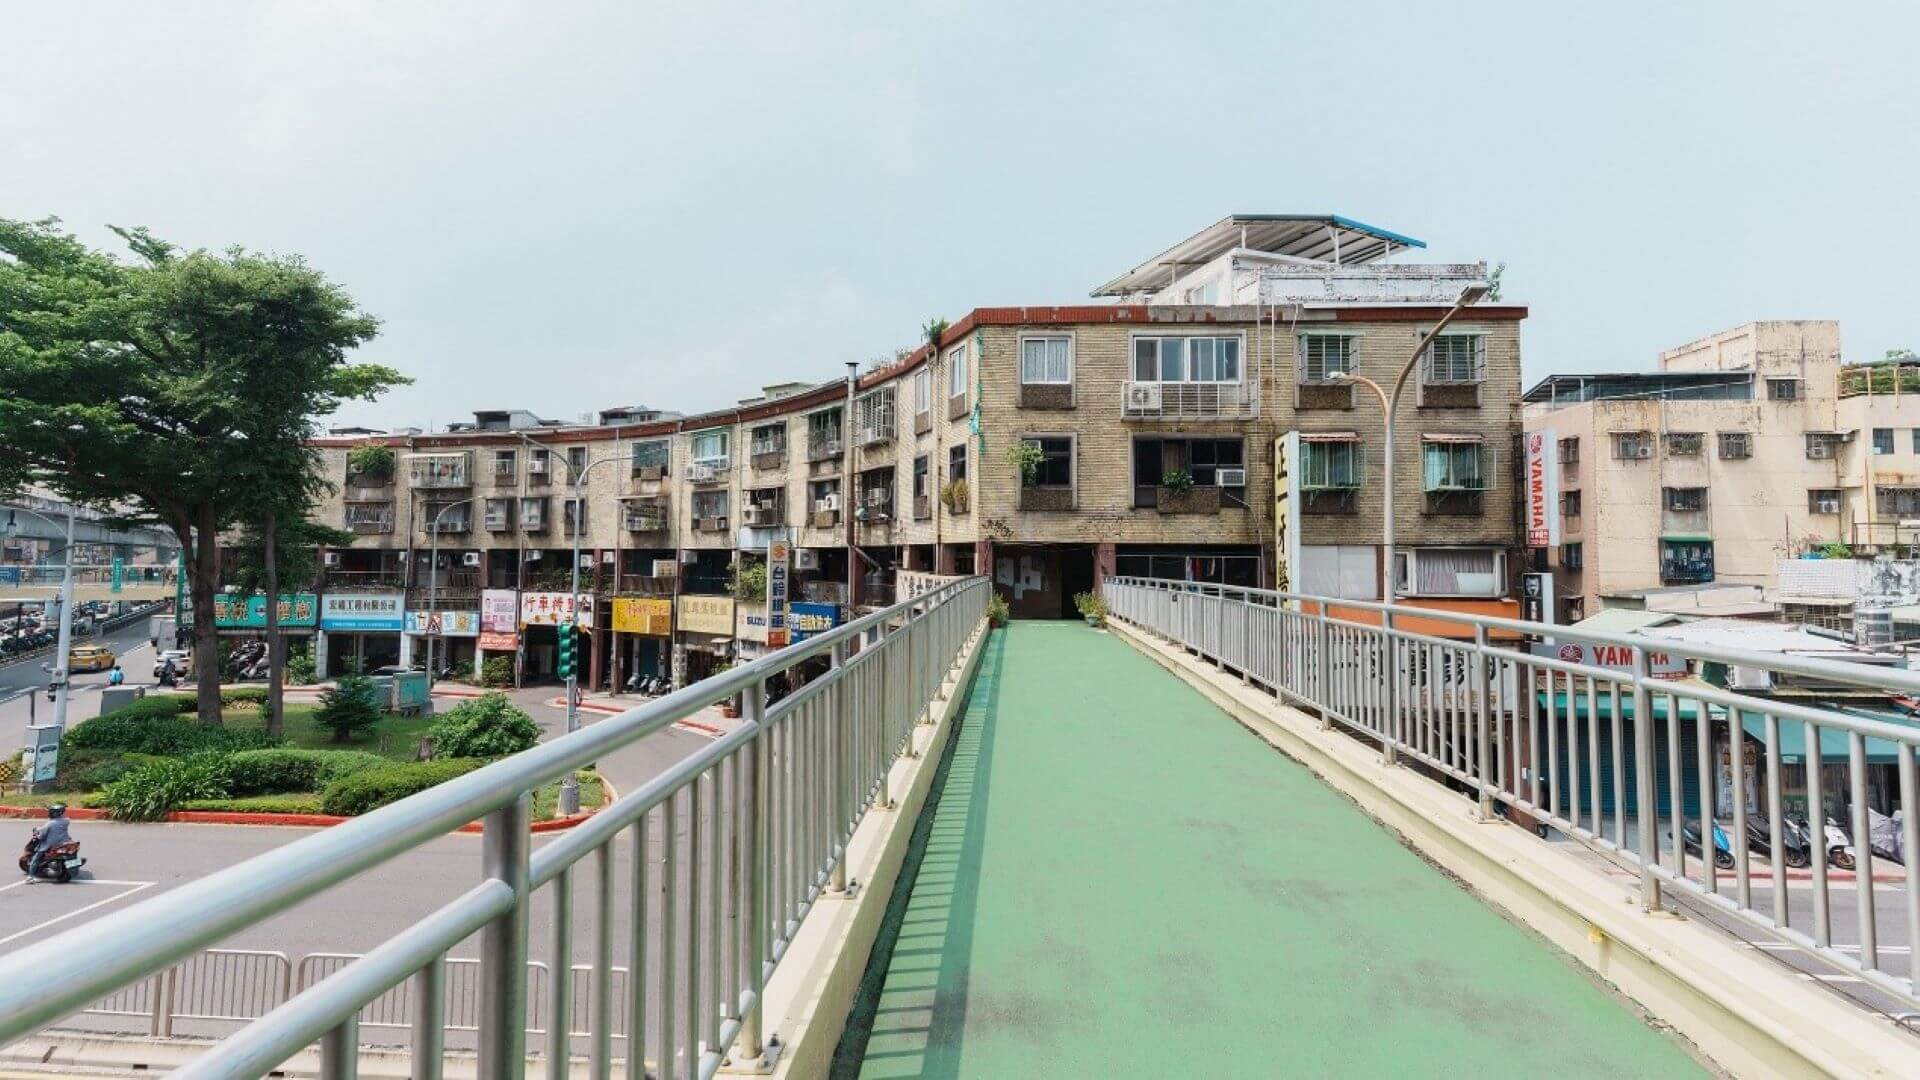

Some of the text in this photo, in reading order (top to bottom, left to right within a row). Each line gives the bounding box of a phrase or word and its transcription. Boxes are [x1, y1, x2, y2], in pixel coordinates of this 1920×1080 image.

[1531, 458, 1544, 528] YAMAHA
[746, 616, 767, 627] SUZU
[1593, 645, 1670, 668] YAMHA
